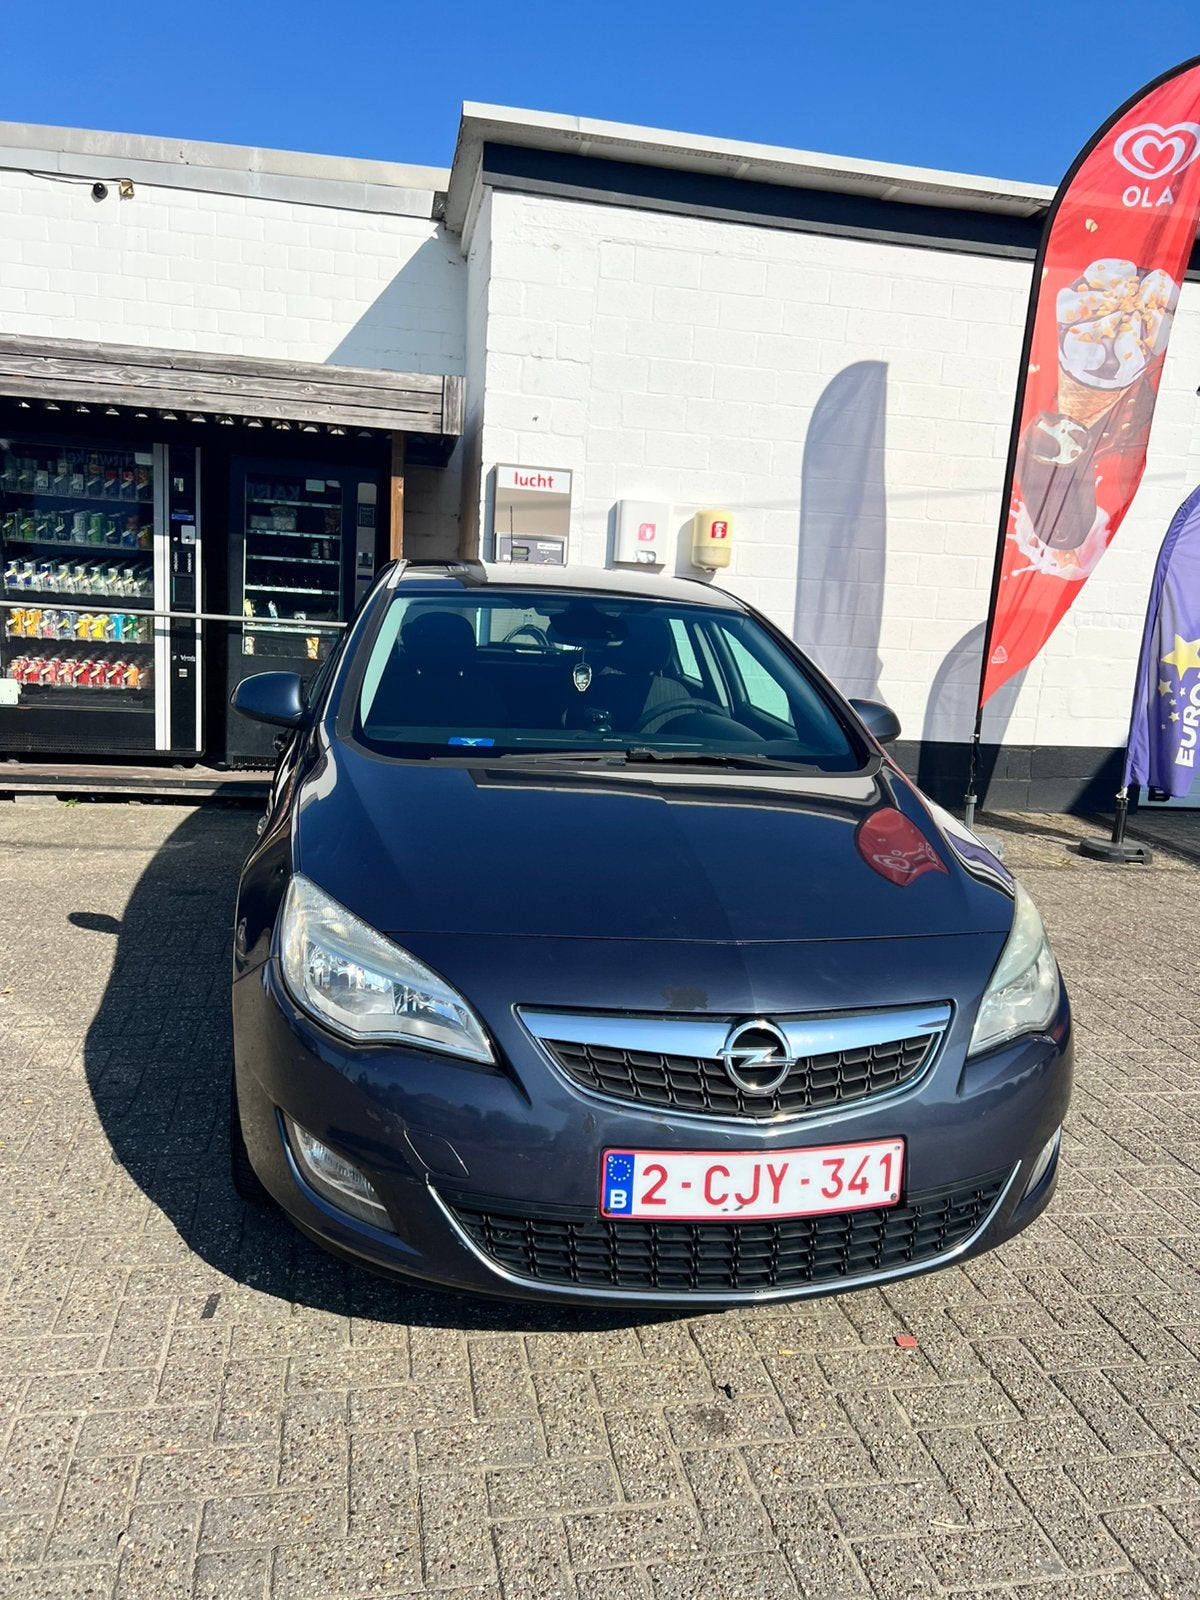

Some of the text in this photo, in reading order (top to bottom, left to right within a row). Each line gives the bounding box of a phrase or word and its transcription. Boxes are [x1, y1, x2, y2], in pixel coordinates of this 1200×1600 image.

[1122, 185, 1174, 207] OLA
[514, 472, 554, 488] lucht
[609, 1189, 628, 1209] B
